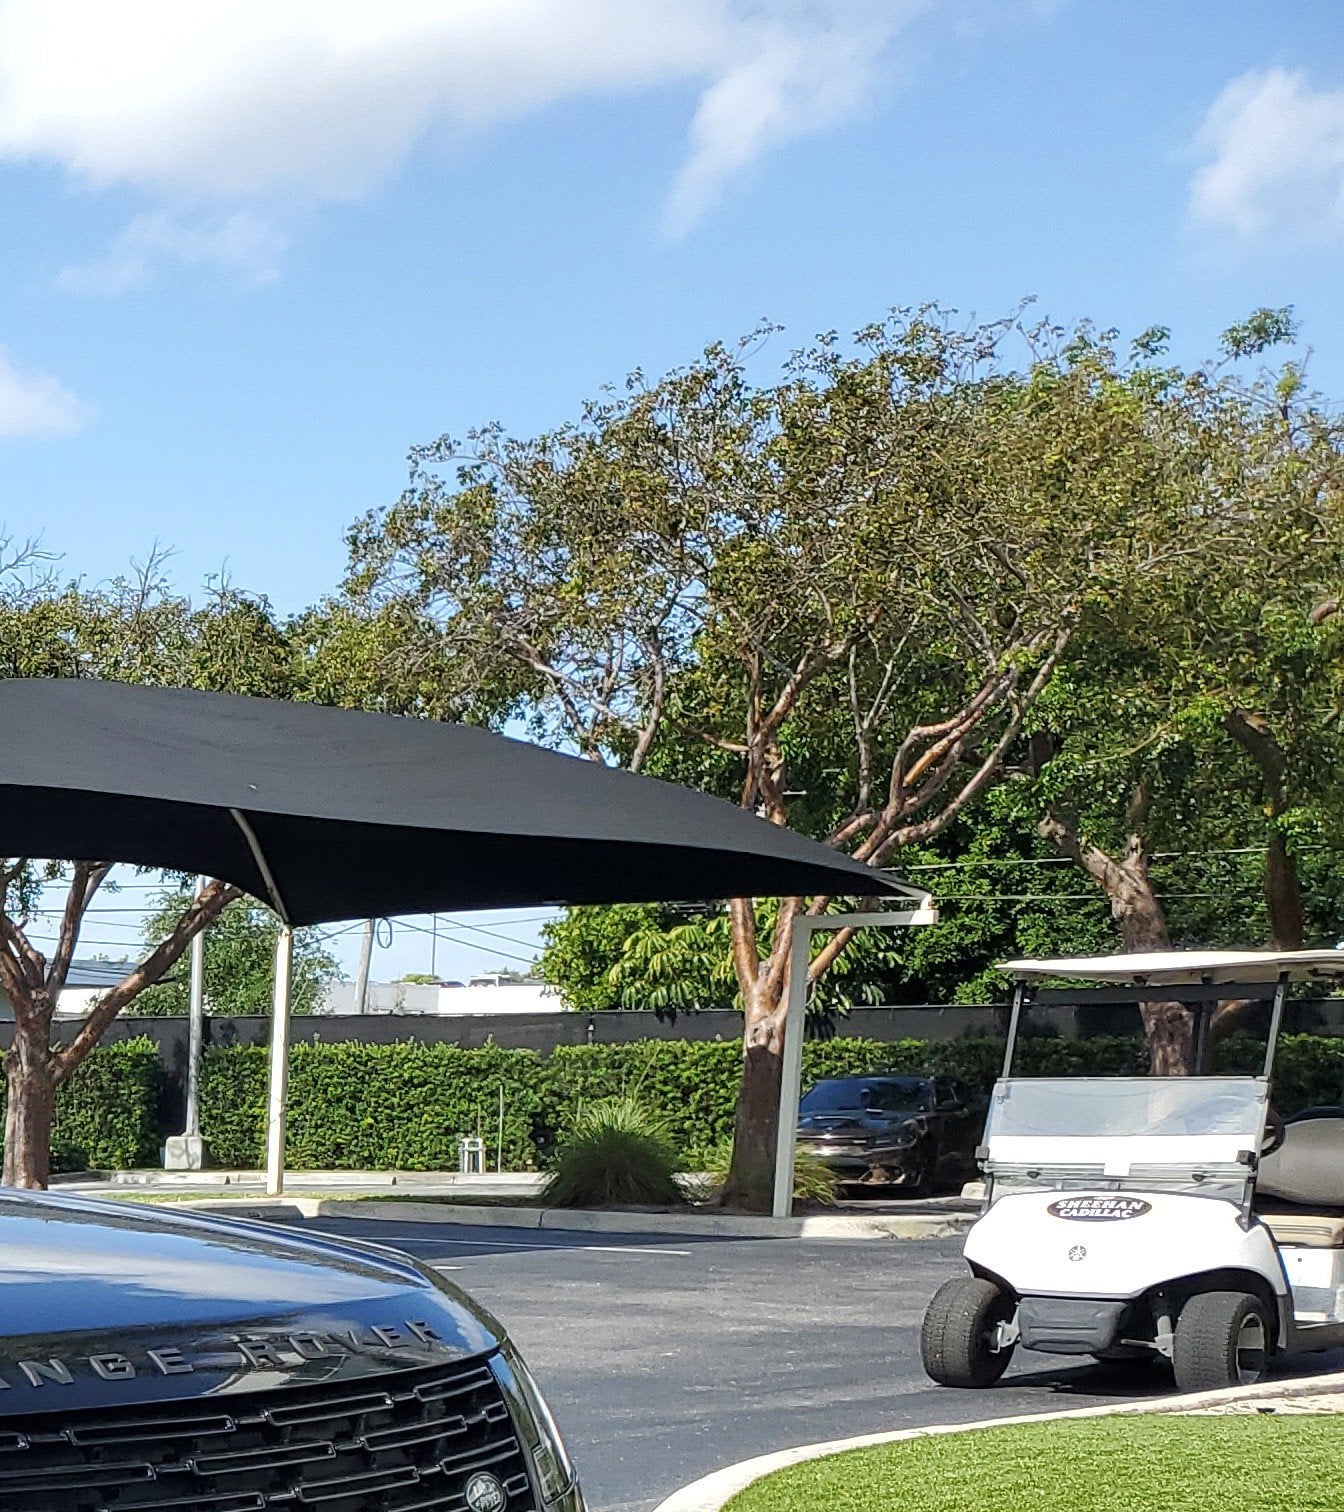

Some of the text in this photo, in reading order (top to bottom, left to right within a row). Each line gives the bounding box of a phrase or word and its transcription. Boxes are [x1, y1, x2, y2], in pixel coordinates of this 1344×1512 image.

[1056, 1200, 1145, 1210] SHEEHAN
[1059, 1208, 1133, 1218] CADILLAC
[237, 1319, 442, 1369] ROVER
